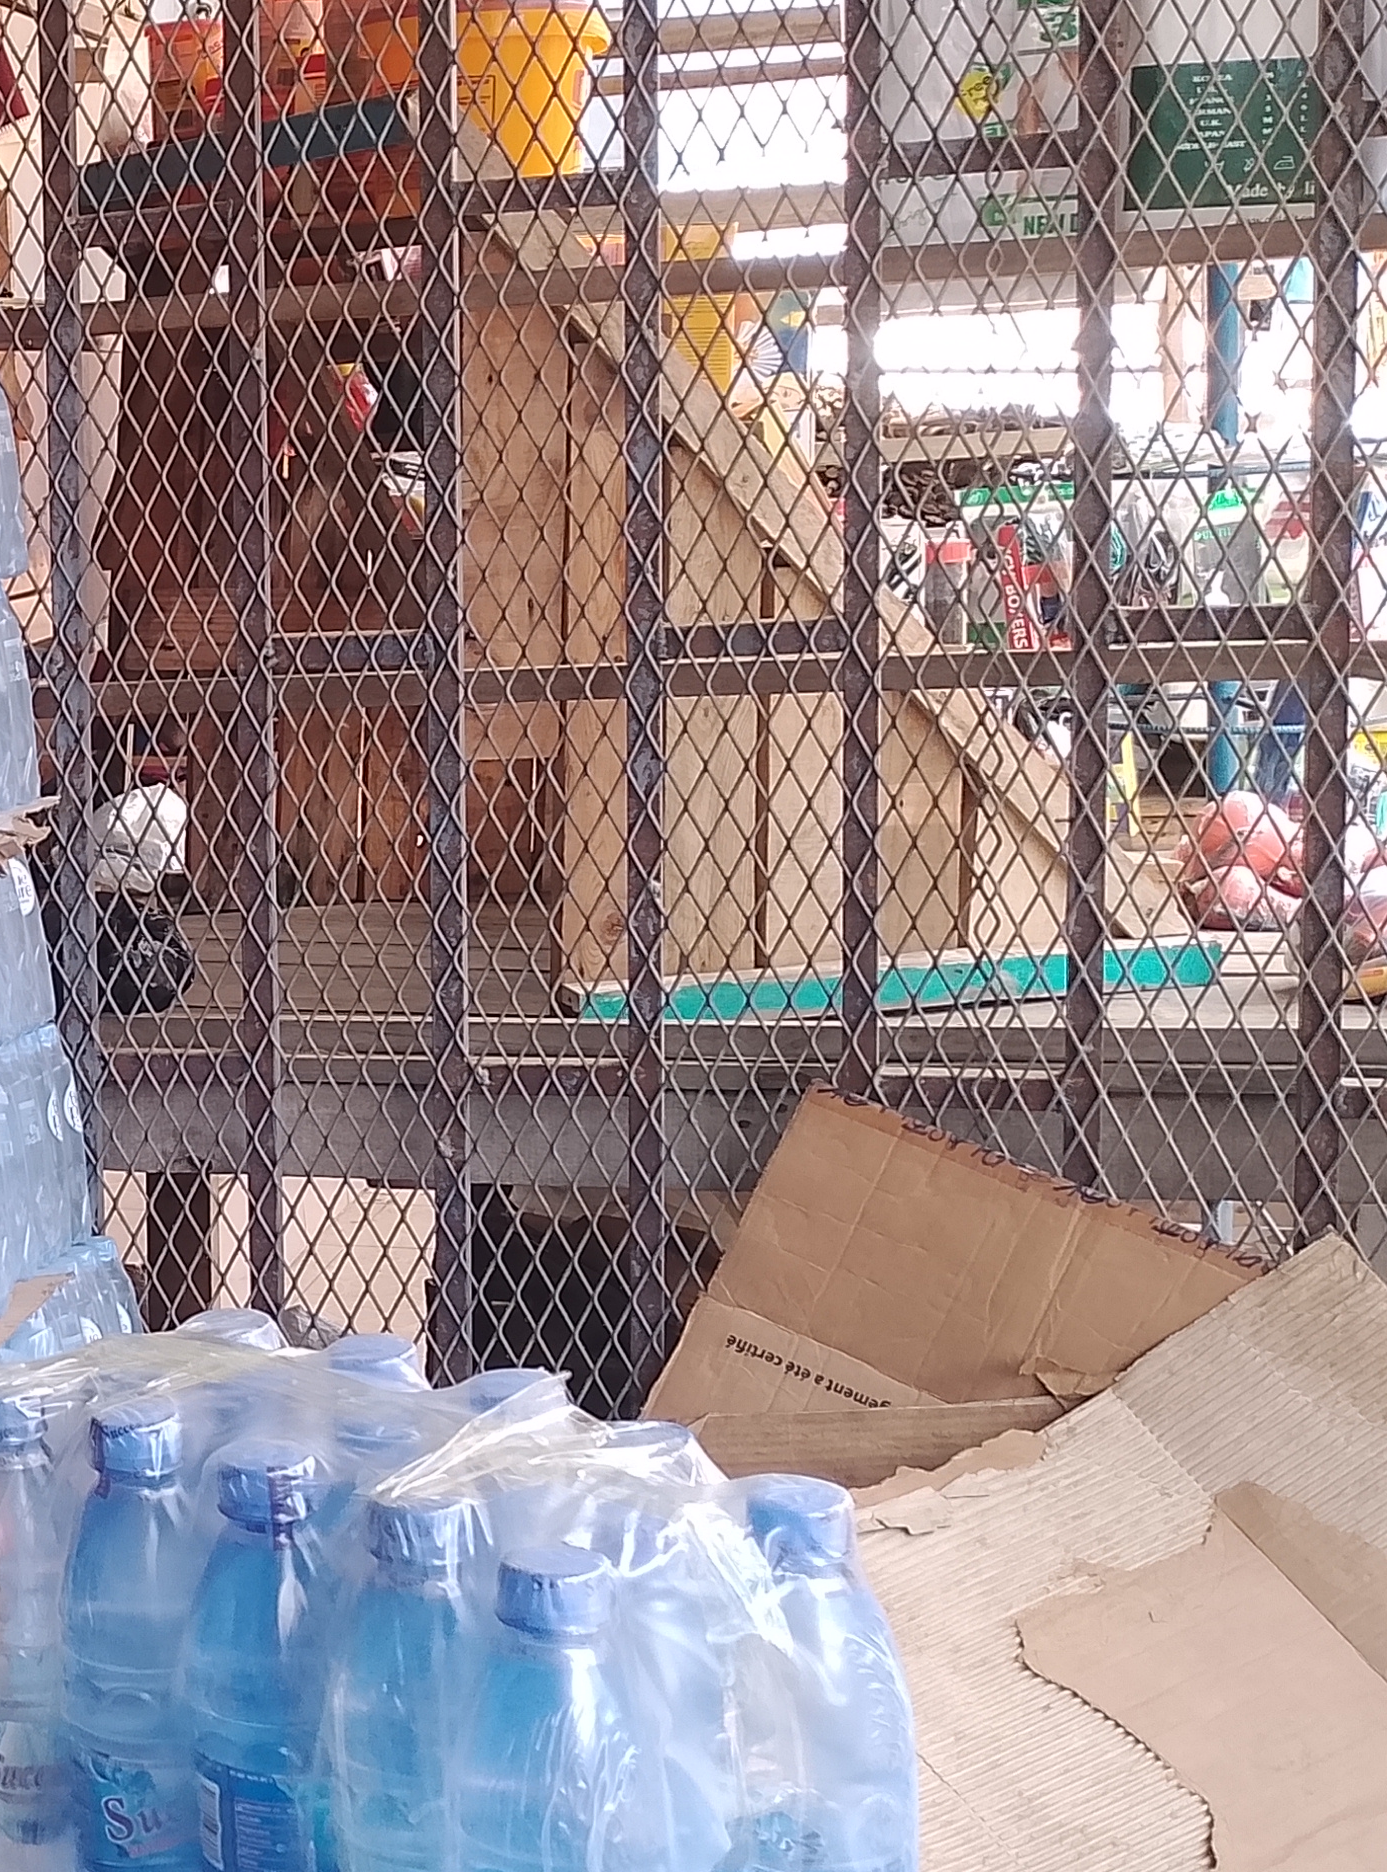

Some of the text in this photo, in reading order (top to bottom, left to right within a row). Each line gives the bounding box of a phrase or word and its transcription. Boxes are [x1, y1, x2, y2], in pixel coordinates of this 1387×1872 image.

[1005, 584, 1029, 649] BOERS
[725, 1334, 783, 1366] certifié
[784, 1361, 811, 1382] été
[814, 1374, 825, 1386] a
